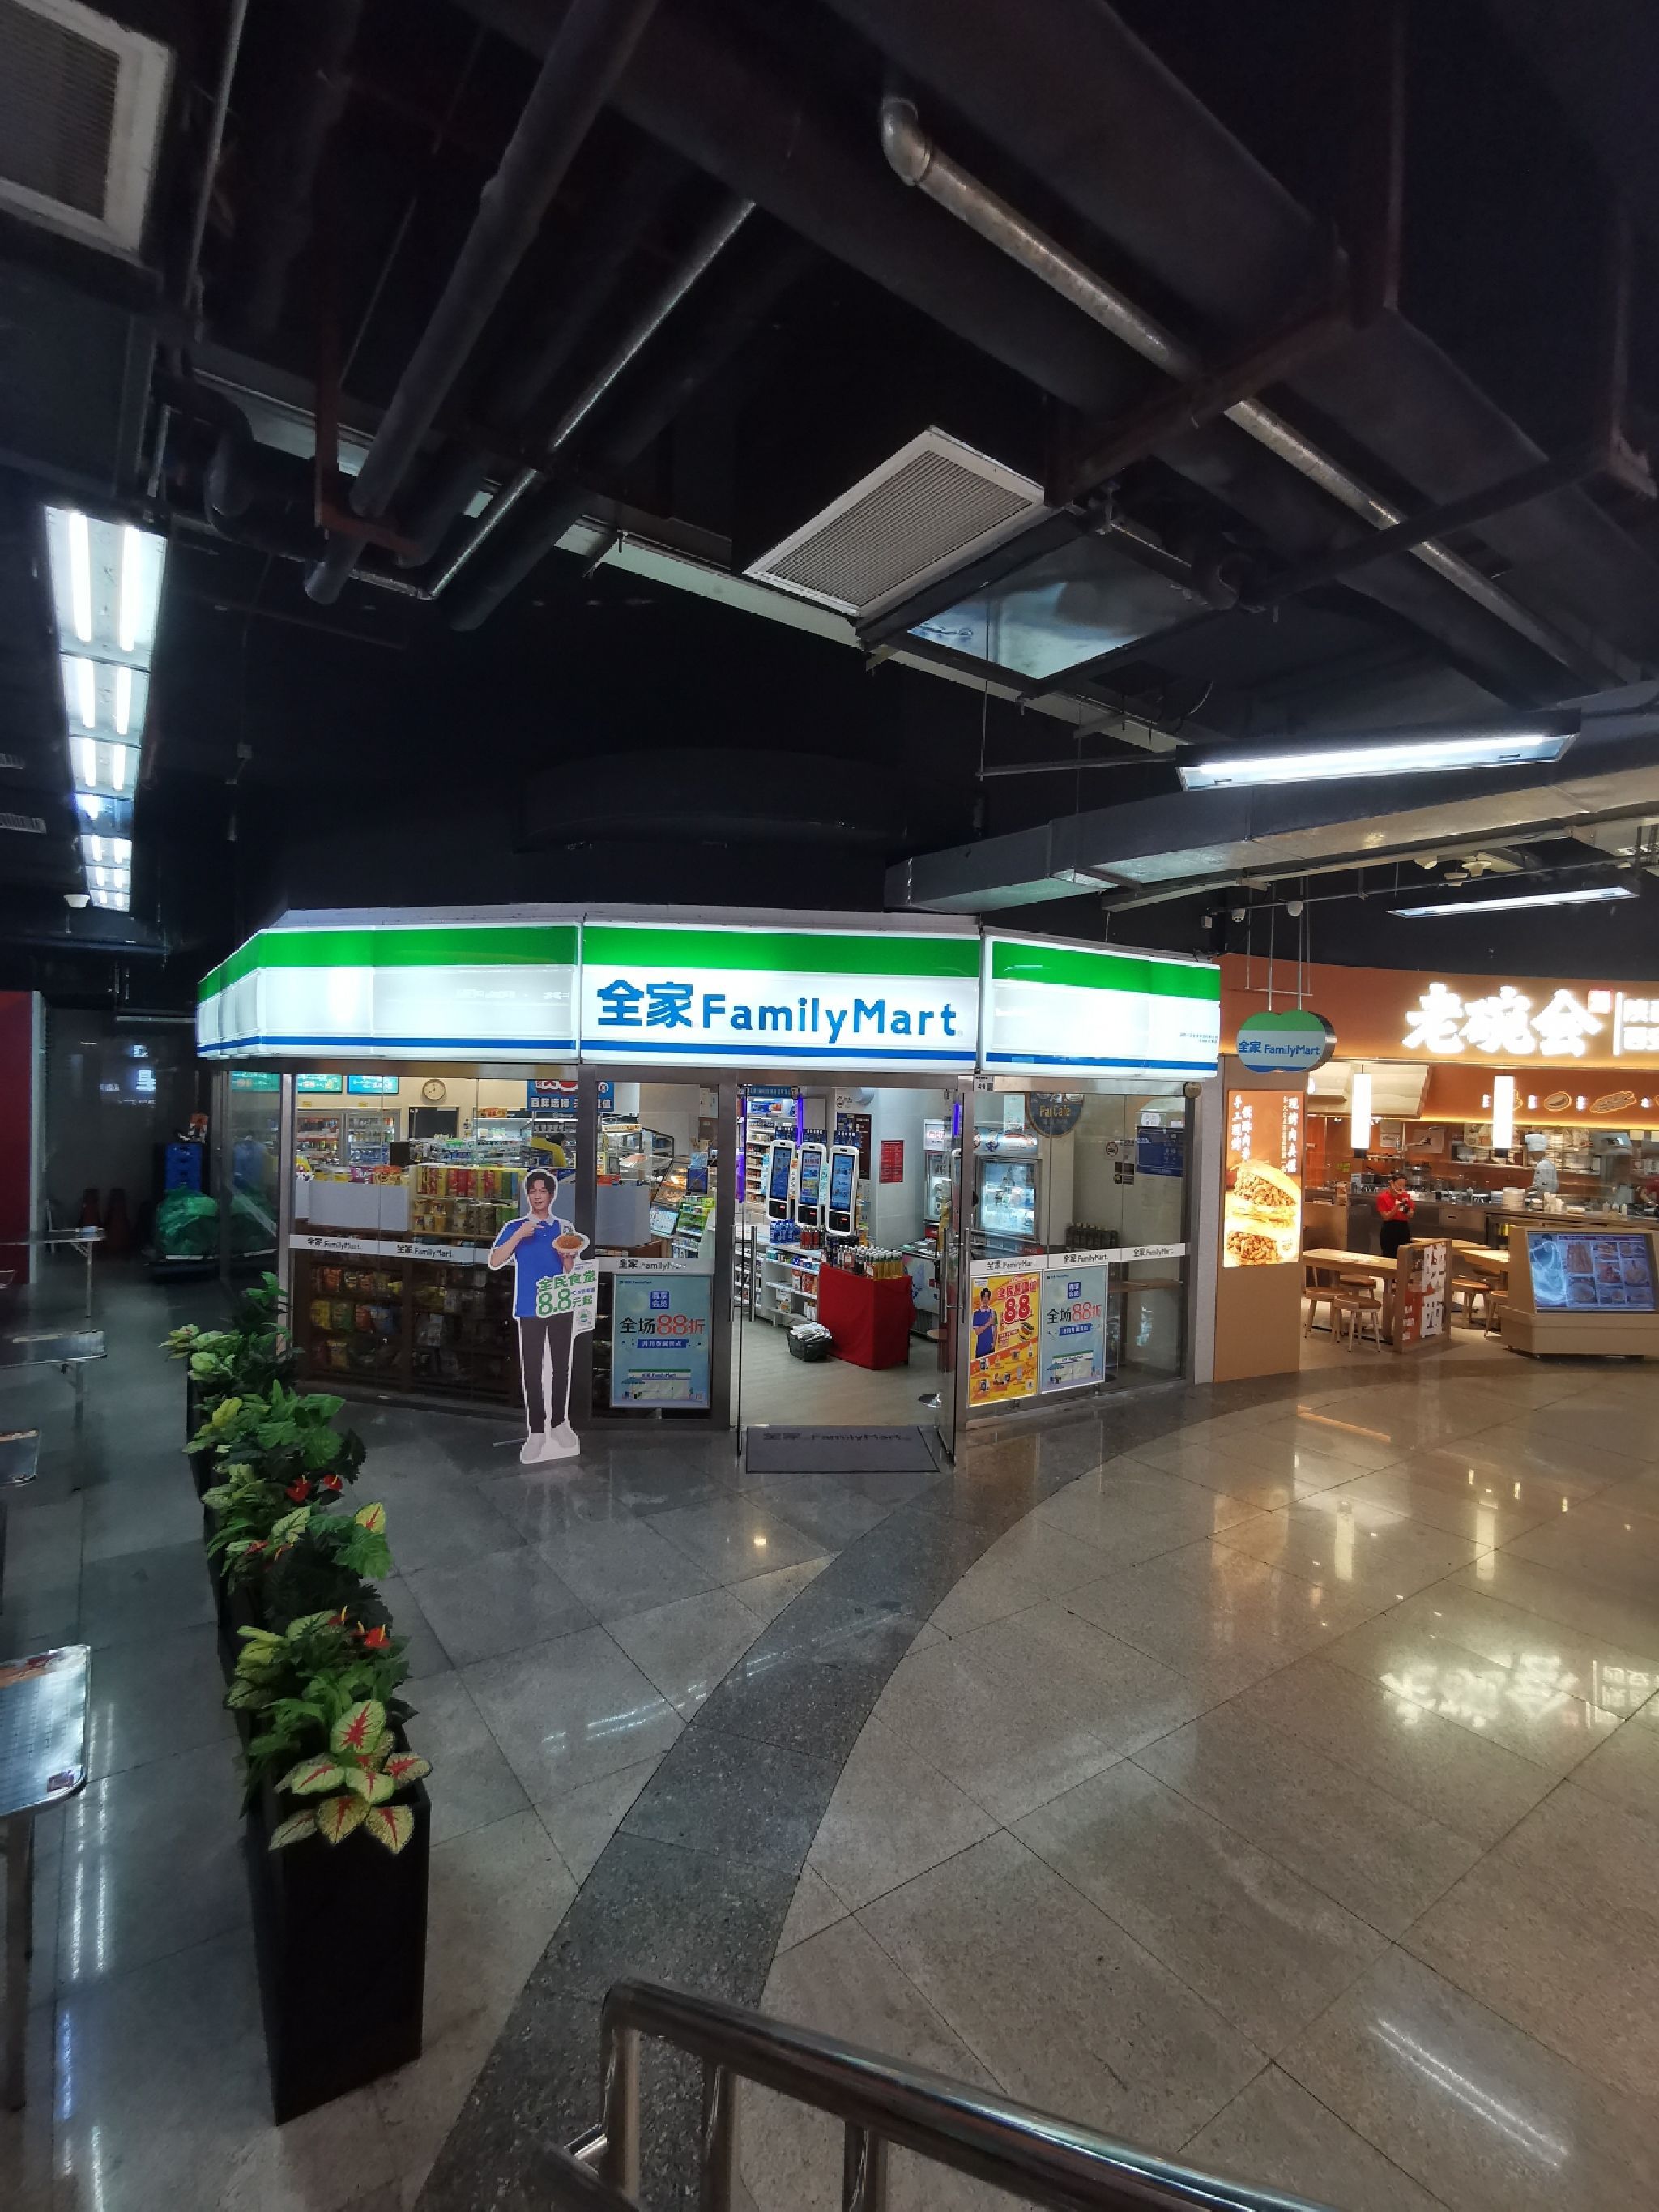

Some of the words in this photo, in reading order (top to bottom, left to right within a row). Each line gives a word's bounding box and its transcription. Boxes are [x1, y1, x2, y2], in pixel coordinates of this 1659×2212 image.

[597, 980, 693, 1028] 全家
[703, 994, 957, 1044] FamilyMart
[1402, 983, 1604, 1057] 老碗会
[1239, 1040, 1261, 1053] 全家
[1264, 1044, 1320, 1057] FamilyMart
[307, 1237, 322, 1246] 全家
[324, 1240, 360, 1250] FamilyMart
[397, 1245, 412, 1253] 全家
[415, 1247, 451, 1258] FamilyMart
[1077, 1254, 1107, 1262] FamilyMart
[619, 1259, 638, 1269] 全家
[1003, 1260, 1035, 1269] FamilyMart
[1047, 1302, 1102, 1324] 全场88折
[619, 1314, 706, 1335] 全场88折
